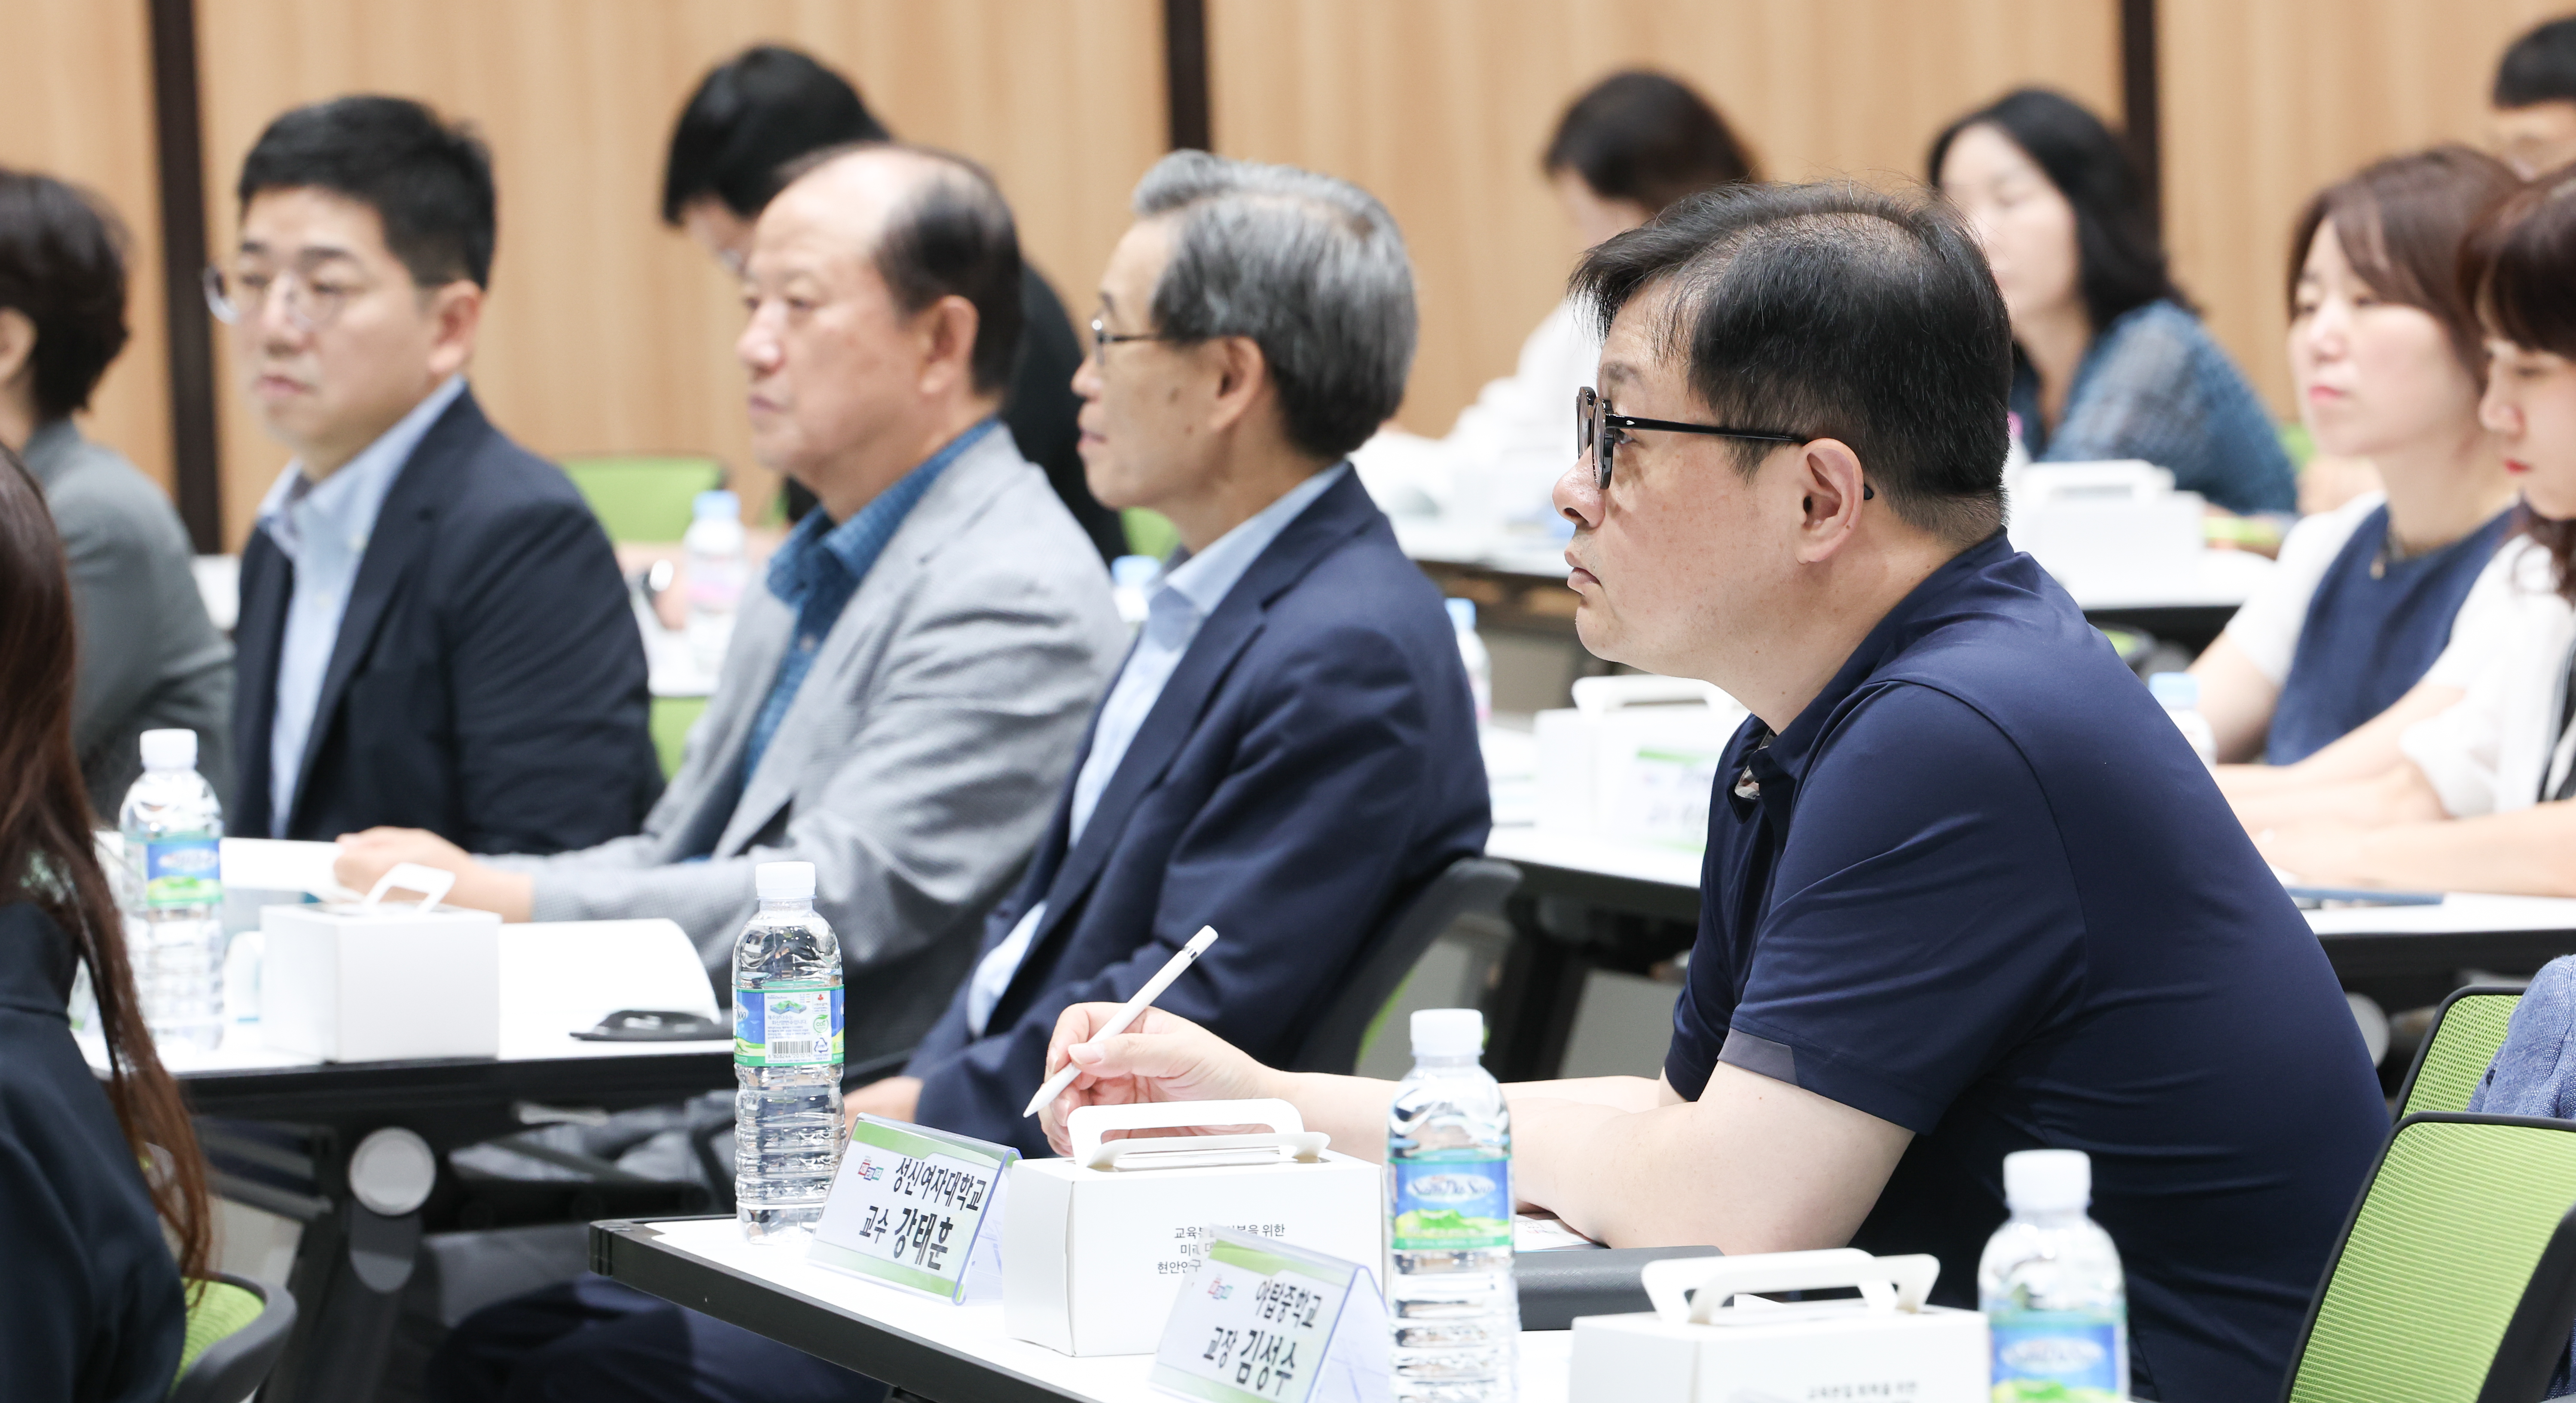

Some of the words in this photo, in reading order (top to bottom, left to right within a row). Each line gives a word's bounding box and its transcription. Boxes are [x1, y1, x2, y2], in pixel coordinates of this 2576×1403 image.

[893, 1157, 987, 1211] 성신여자대학교
[859, 1205, 889, 1244] 교수
[893, 1207, 954, 1271] 강태훈
[1262, 1223, 1285, 1237] 위한
[1203, 1327, 1238, 1369] 교장
[1236, 1330, 1297, 1396] 김성수
